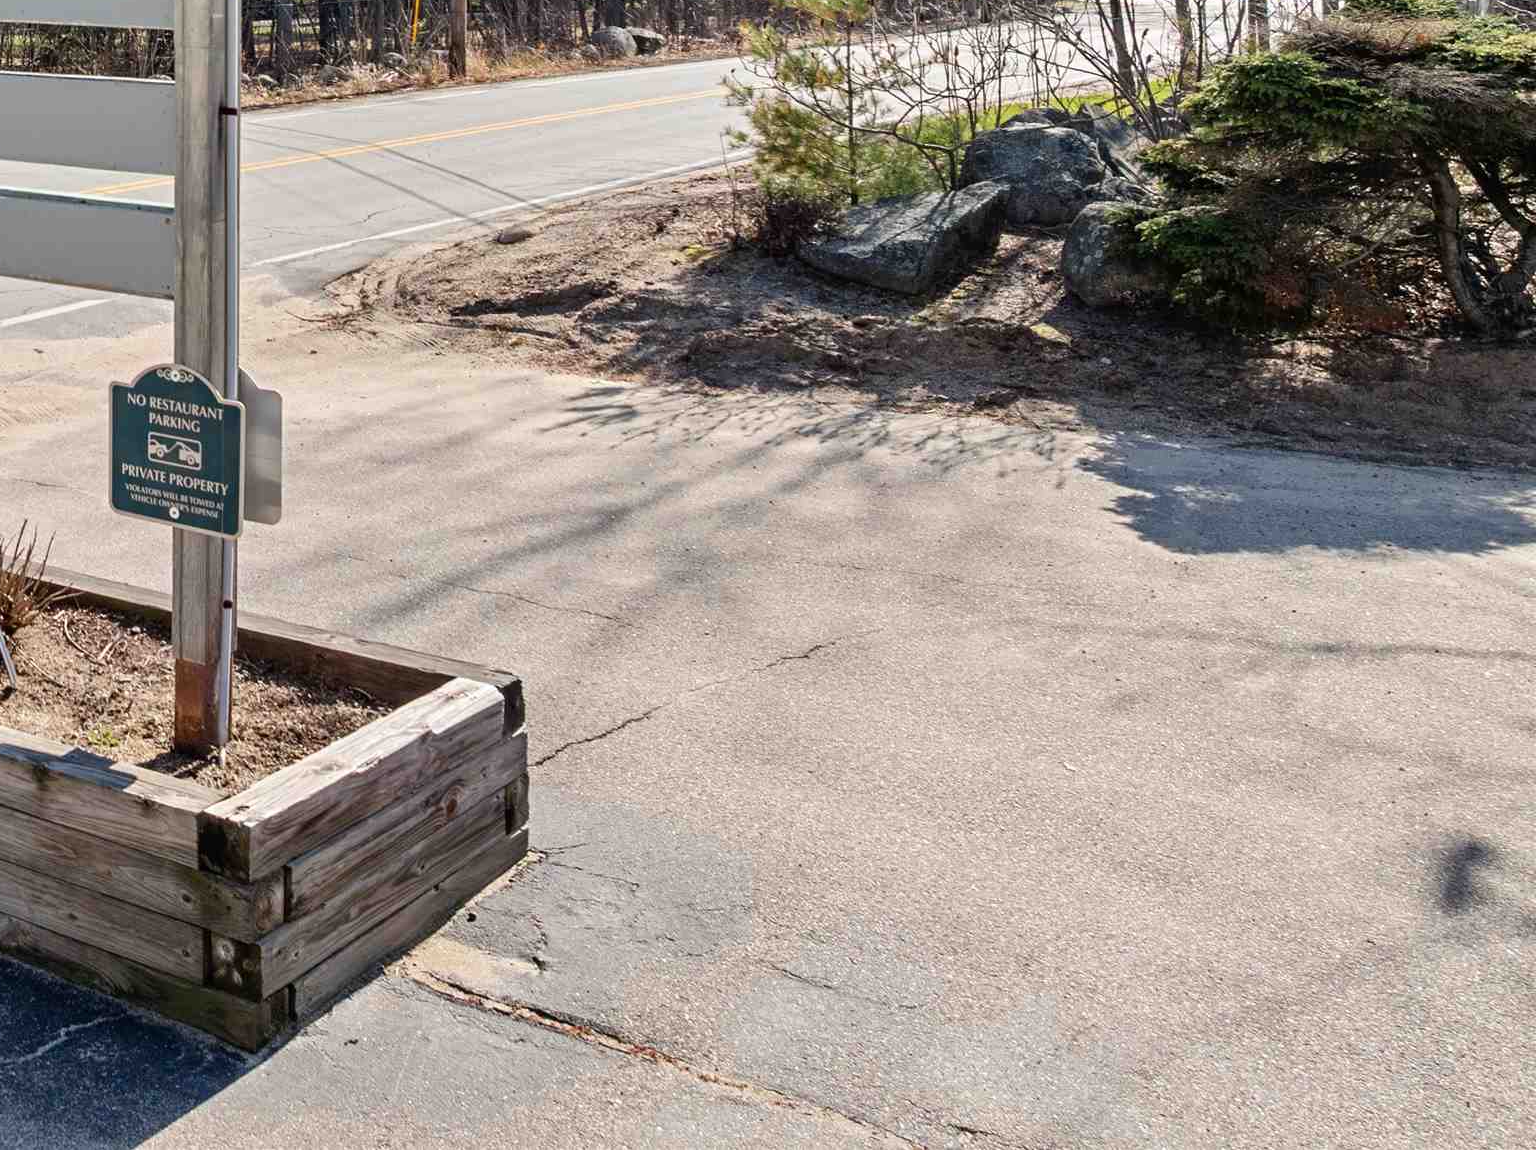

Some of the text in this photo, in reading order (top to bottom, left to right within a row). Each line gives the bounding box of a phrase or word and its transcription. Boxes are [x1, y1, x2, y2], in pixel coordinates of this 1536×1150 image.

[127, 392, 224, 420] NO RESTAURANT
[148, 412, 200, 433] PARKING
[121, 462, 229, 496] PRIVATE PROPERTY
[125, 483, 225, 511] VIOLATORS WILL BE TOWED AT
[129, 493, 157, 505] VEHICLE
[190, 505, 219, 519] EXPENSE
